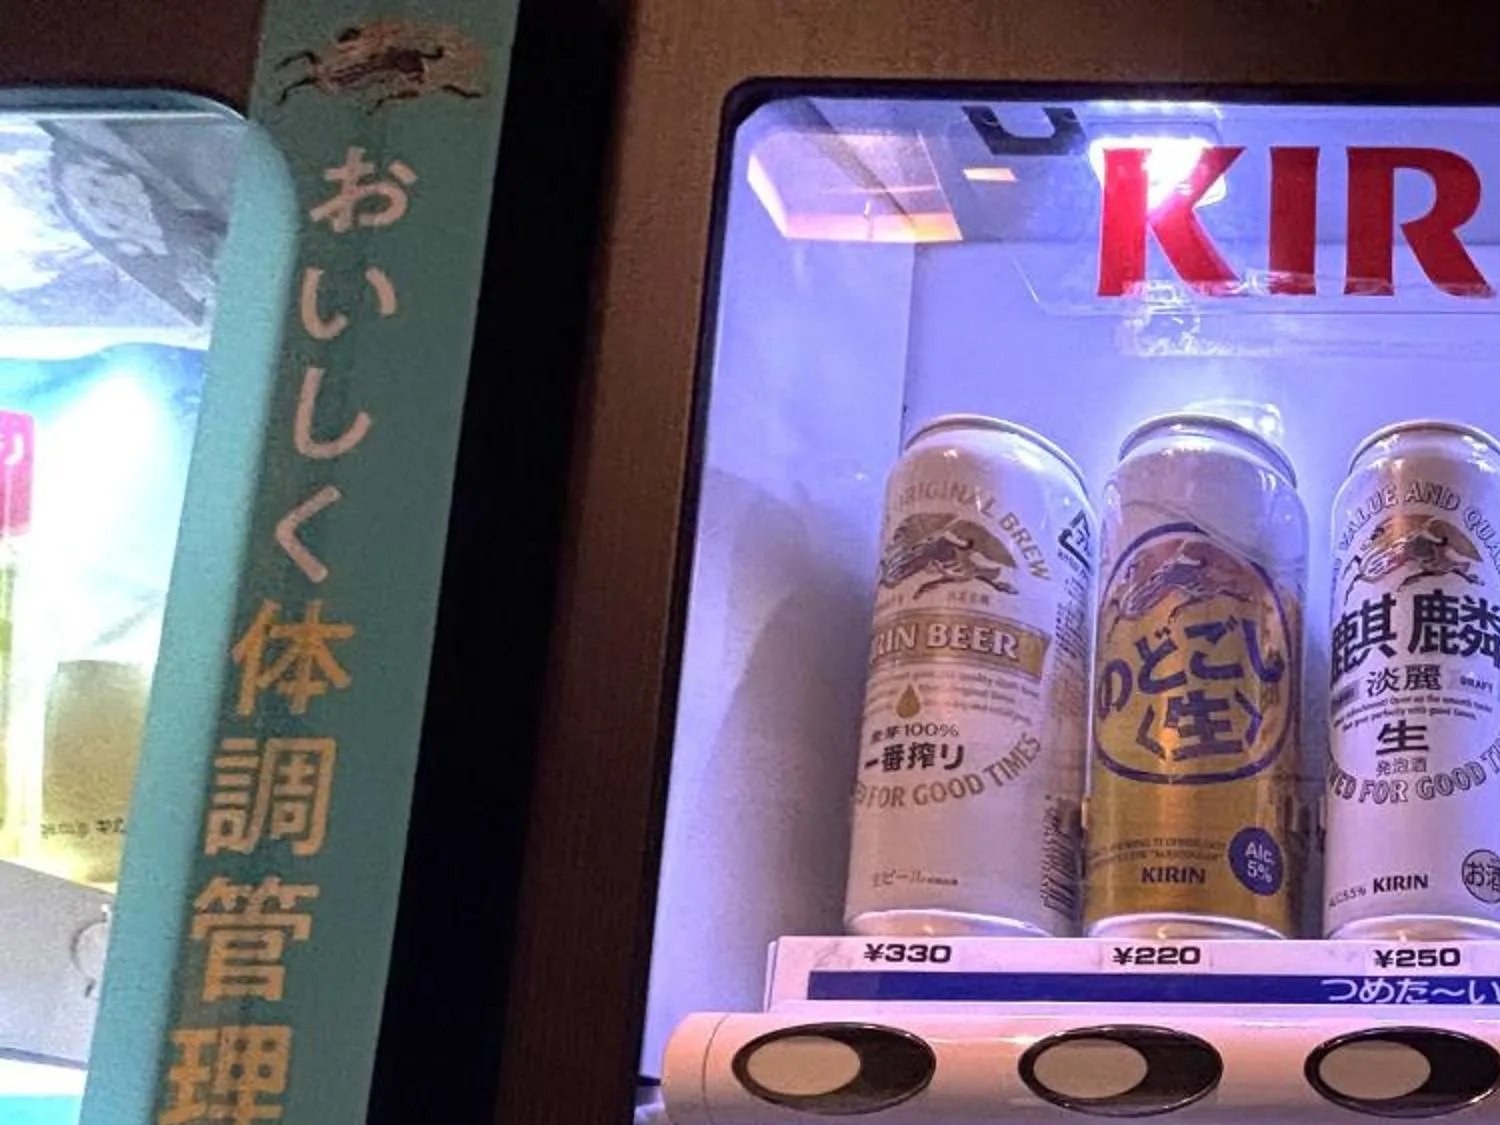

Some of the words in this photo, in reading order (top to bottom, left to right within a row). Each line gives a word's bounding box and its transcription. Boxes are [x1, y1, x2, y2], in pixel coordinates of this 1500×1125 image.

[1338, 486, 1399, 552] VALUE
[1404, 481, 1461, 512] AND
[1000, 512, 1051, 581] BREW
[926, 622, 1018, 660] BEER
[1367, 663, 1442, 697] 淡麗
[1375, 719, 1430, 756] 生
[864, 742, 966, 772] 一番搾り
[912, 773, 985, 806] GOOD
[985, 732, 1041, 786] TIMES
[1358, 779, 1408, 804] FOR
[1415, 761, 1487, 801] GOOD
[1141, 866, 1206, 884] KIRIN
[1373, 873, 1429, 893] KIRIN
[863, 943, 952, 963] ¥330
[1113, 946, 1201, 966] ¥220
[1374, 947, 1461, 969] ¥250
